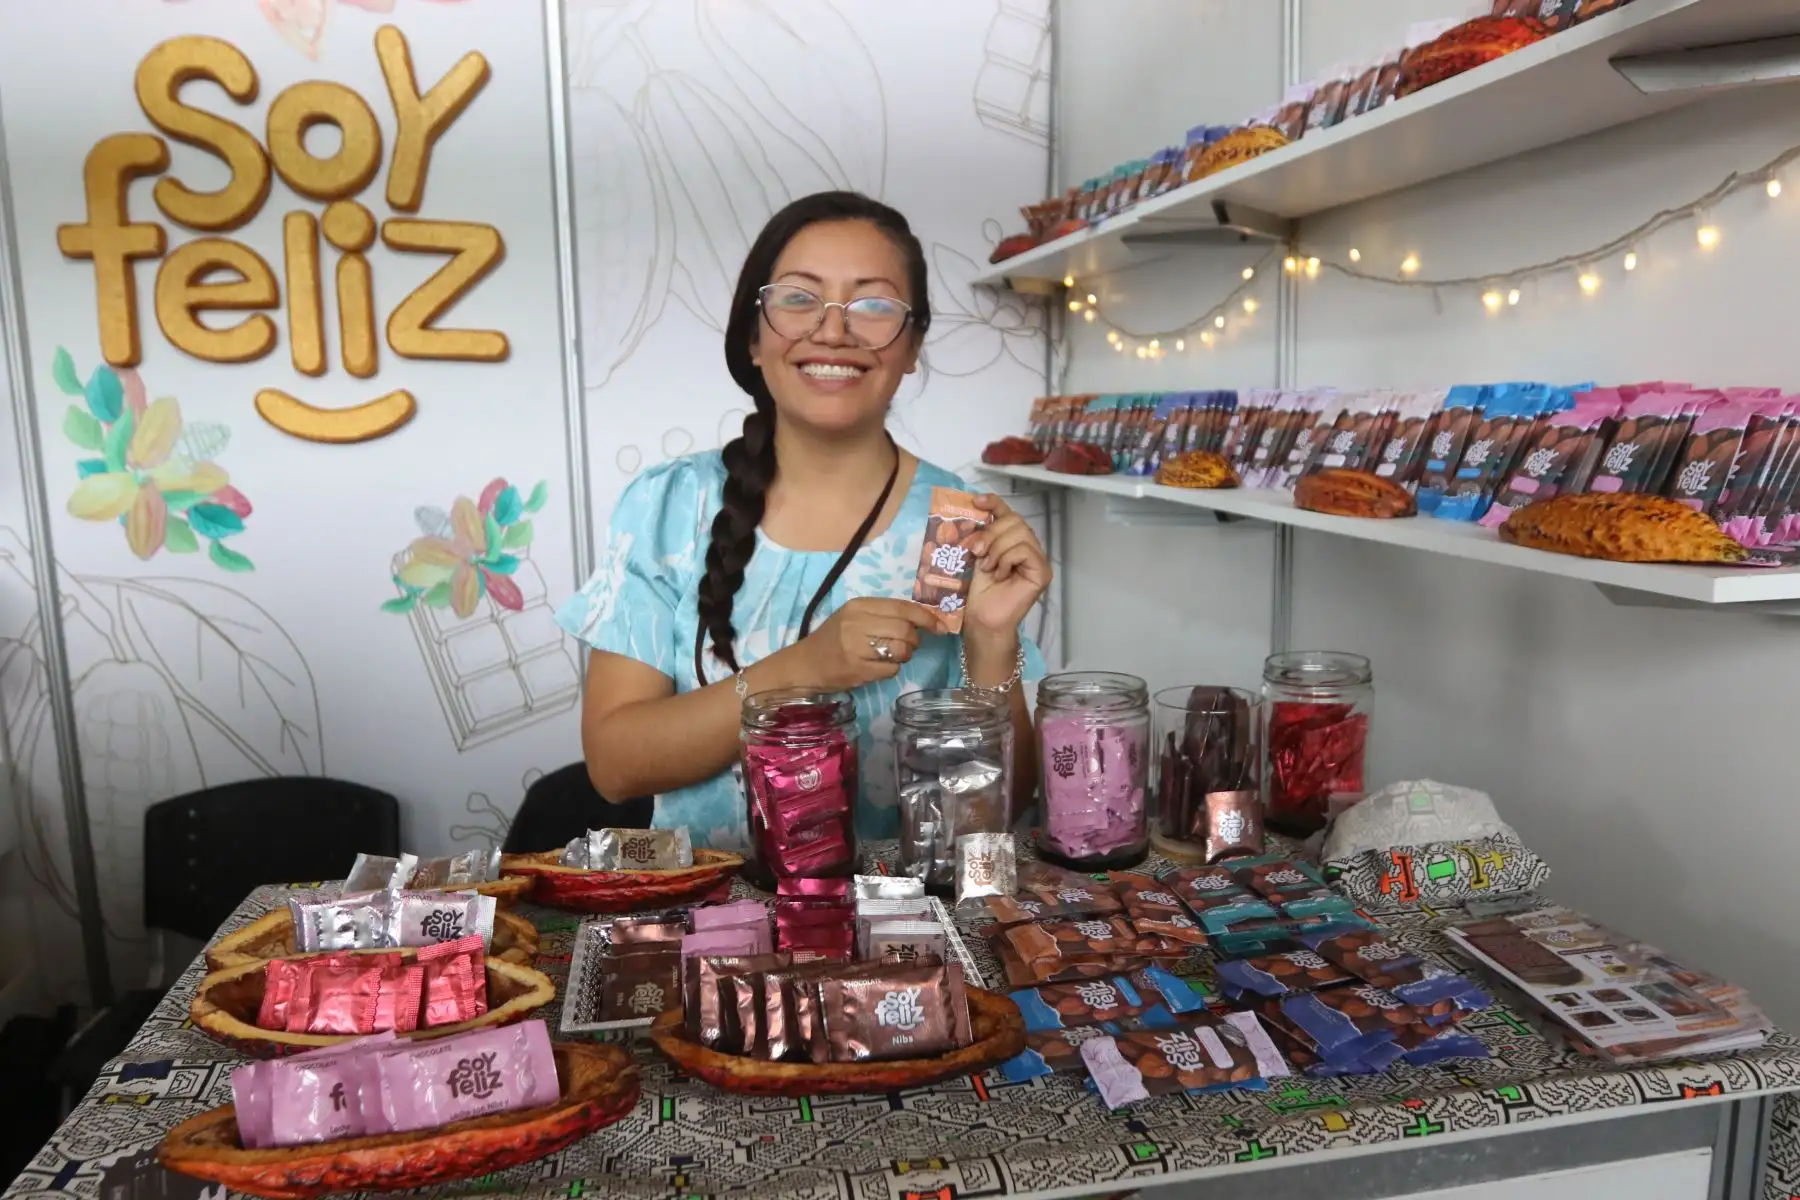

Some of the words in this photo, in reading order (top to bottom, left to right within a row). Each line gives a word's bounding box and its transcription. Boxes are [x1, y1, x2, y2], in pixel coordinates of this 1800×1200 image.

[56, 132, 512, 379] feliz
[874, 1000, 925, 1026] feliz
[1170, 1032, 1204, 1072] feliz
[446, 1070, 503, 1098] feliz
